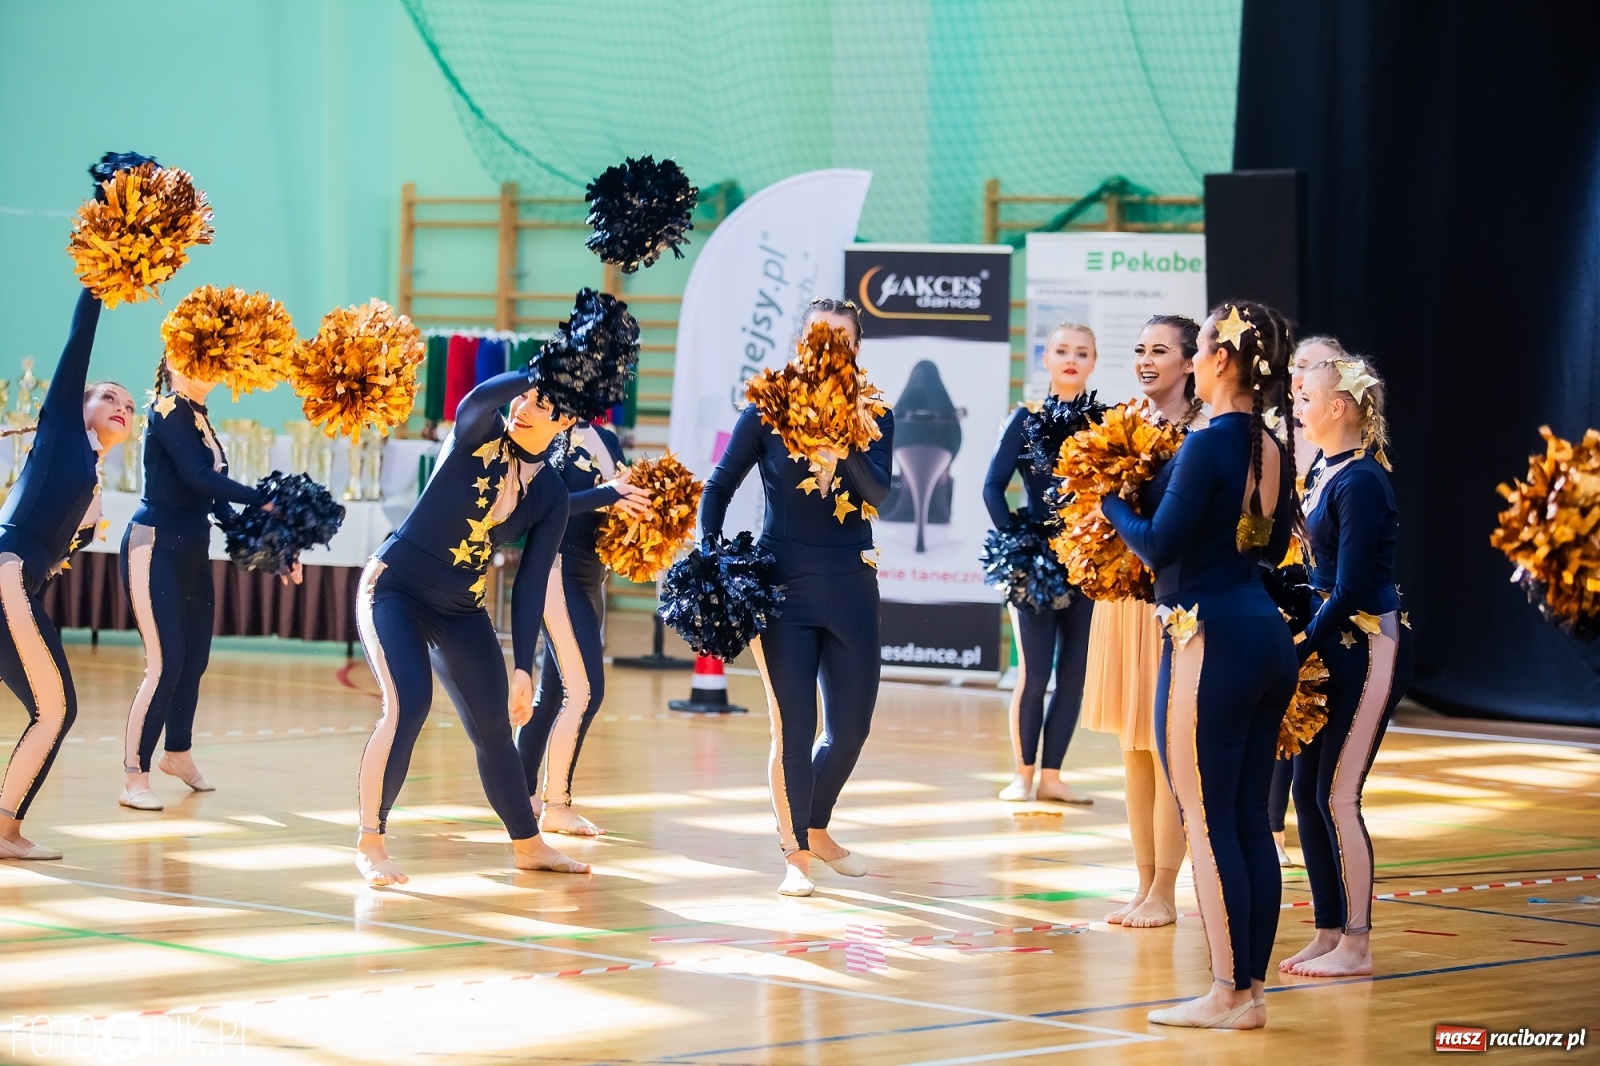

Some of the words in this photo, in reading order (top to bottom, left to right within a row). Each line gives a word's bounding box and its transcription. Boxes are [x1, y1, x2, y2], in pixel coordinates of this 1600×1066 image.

[898, 275, 982, 298] AKCES
[916, 295, 981, 309] dance
[879, 568, 905, 580] wie
[911, 569, 985, 585] taneczn
[881, 642, 982, 668] esdance.pl
